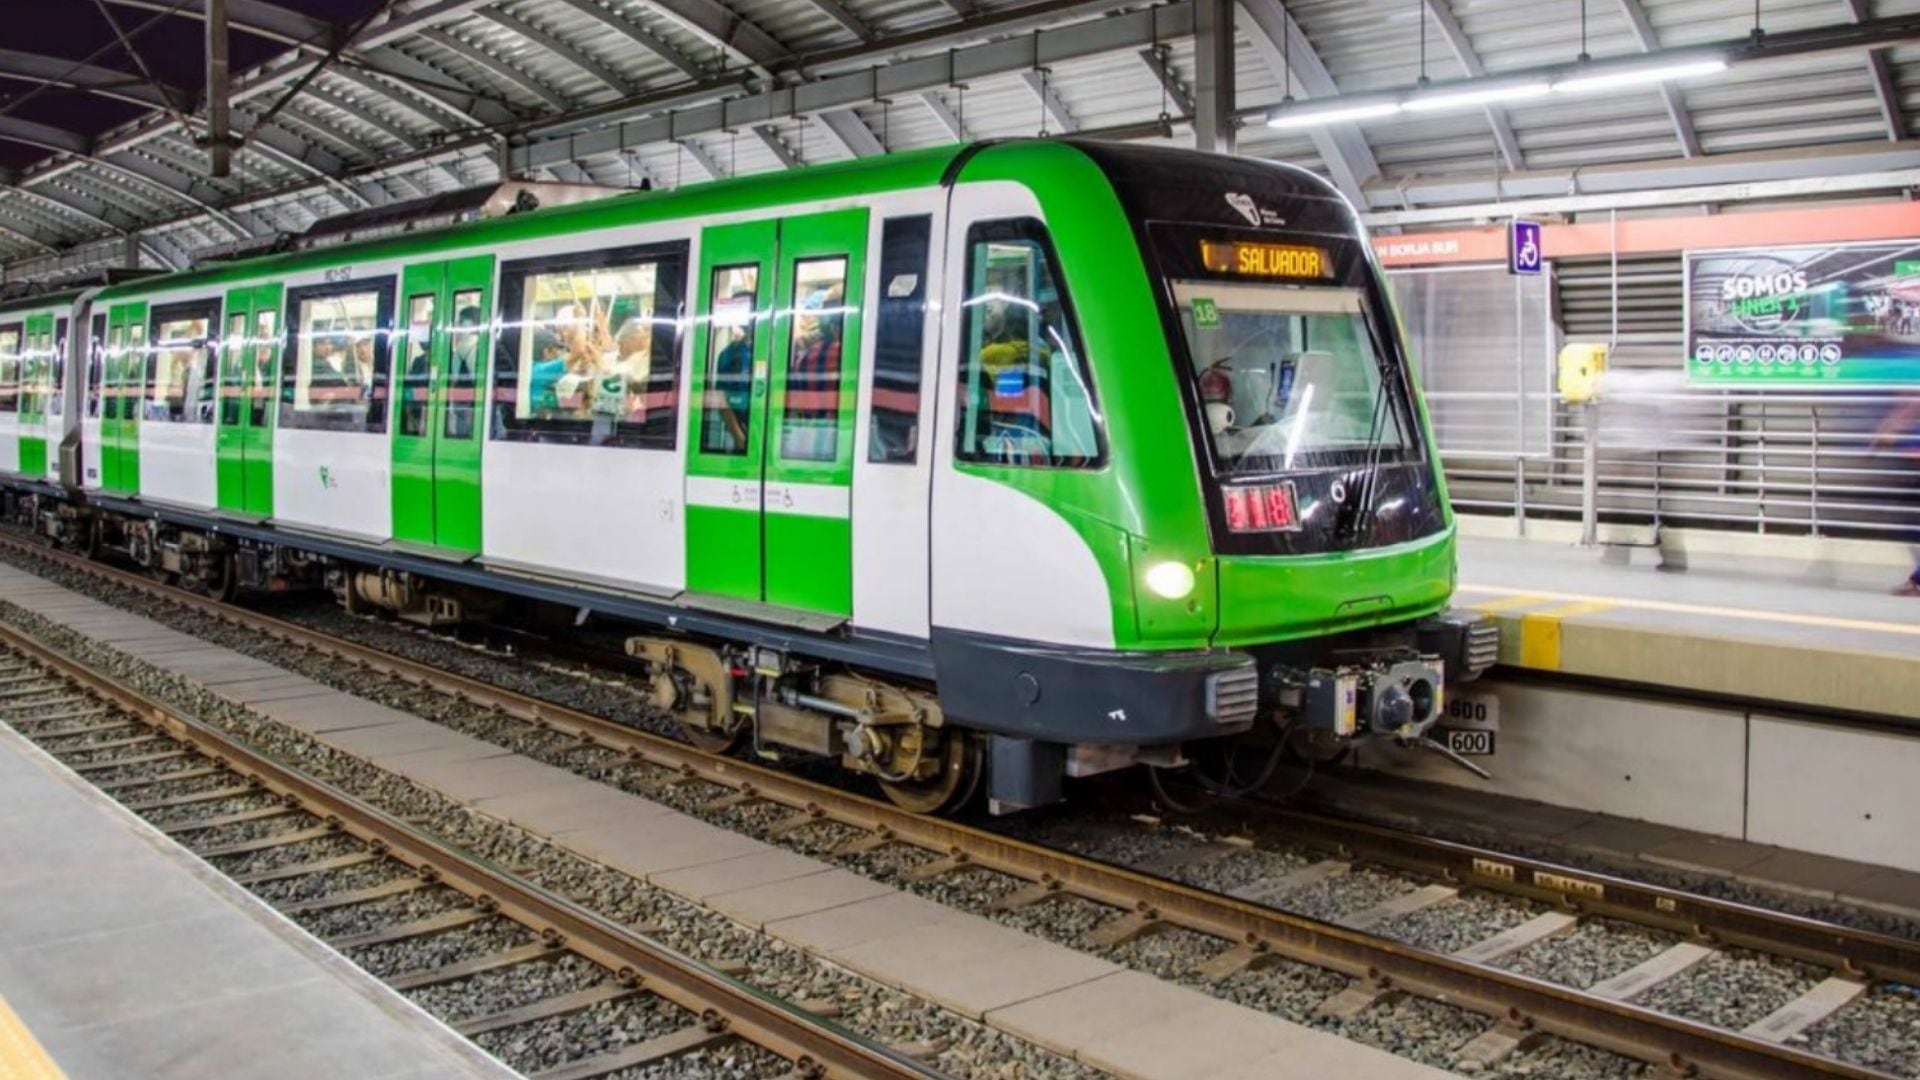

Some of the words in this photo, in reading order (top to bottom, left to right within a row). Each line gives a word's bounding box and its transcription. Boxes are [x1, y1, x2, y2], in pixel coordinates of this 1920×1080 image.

[1389, 242, 1431, 257] BORJA
[1432, 240, 1459, 255] SUR
[1238, 247, 1319, 277] SALVADOR
[1722, 271, 1809, 300] SOMOS
[1194, 304, 1217, 322] 18
[1450, 699, 1487, 722] 600
[1452, 733, 1486, 751] 600
